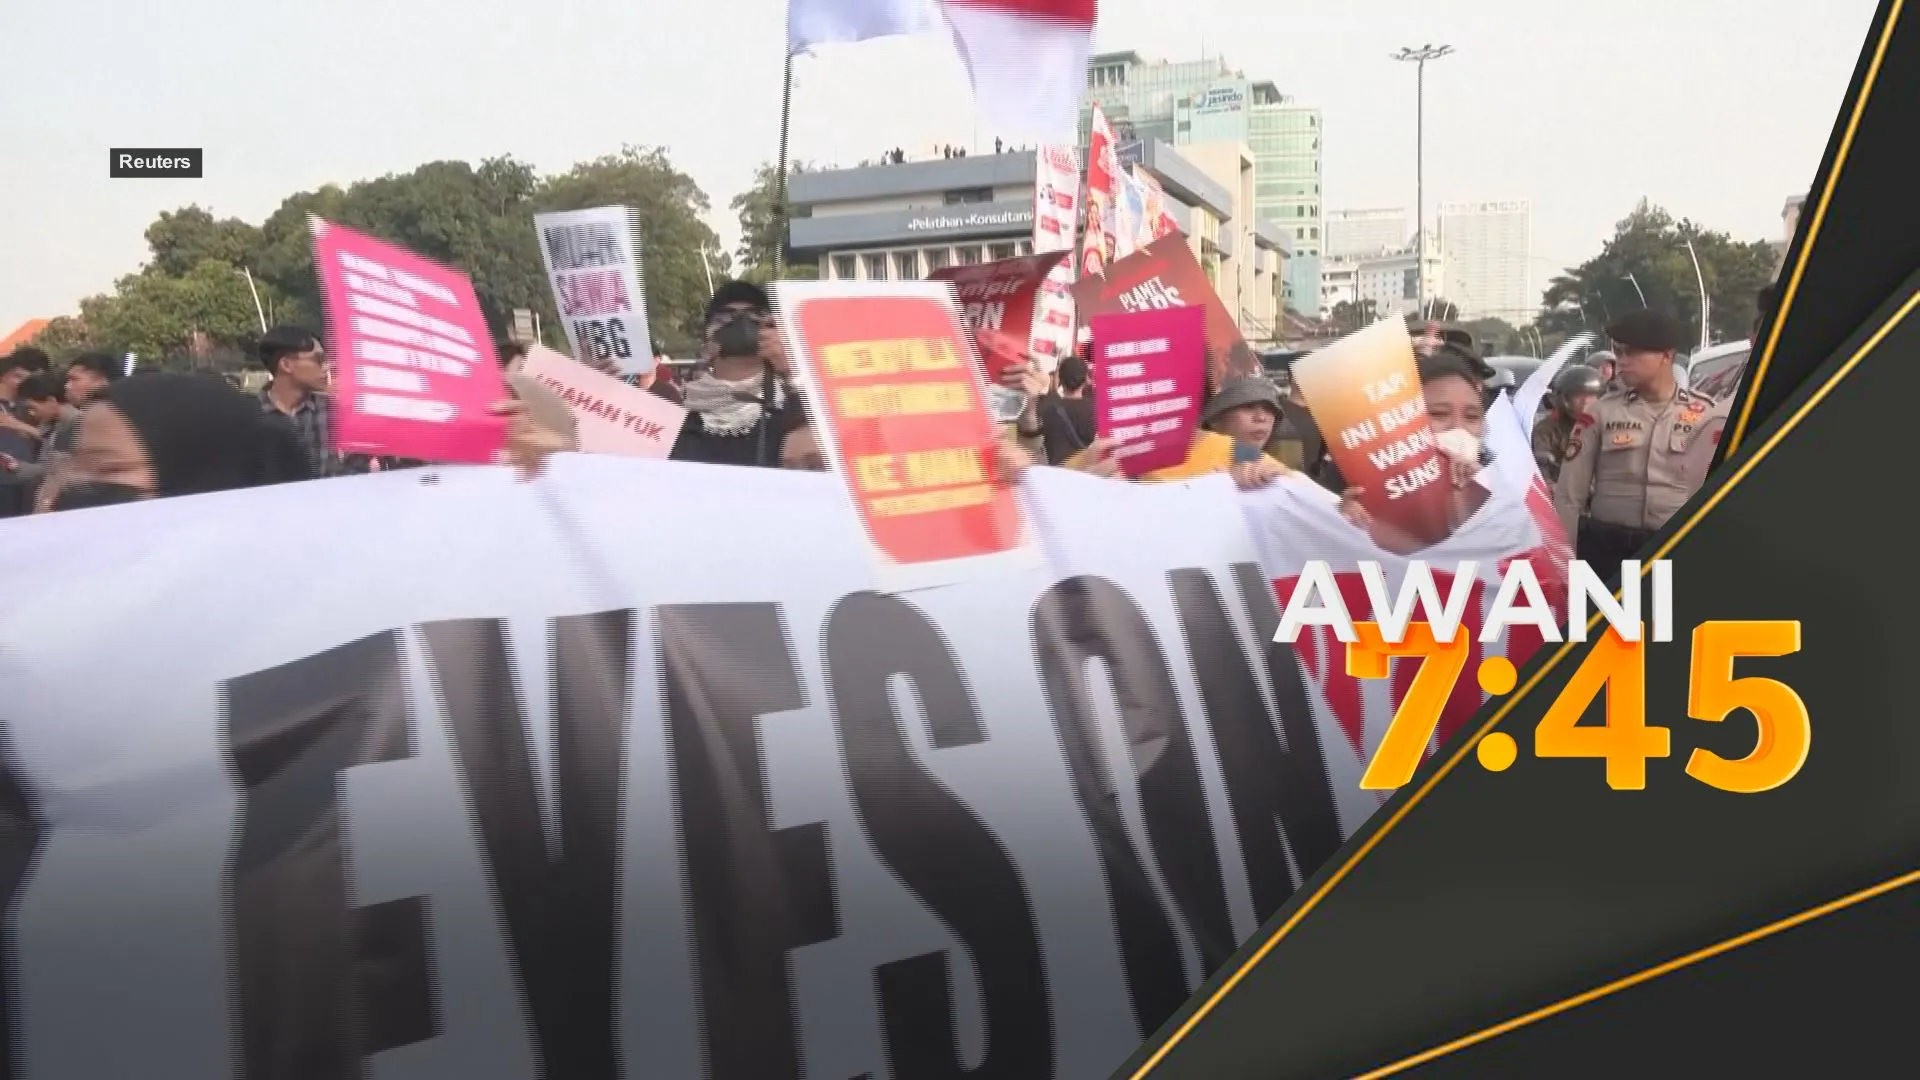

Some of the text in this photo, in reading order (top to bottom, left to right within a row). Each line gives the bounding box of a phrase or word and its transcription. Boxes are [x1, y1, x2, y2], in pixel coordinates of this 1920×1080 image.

[913, 215, 964, 232] Pelatihan
[556, 270, 632, 317] SAMA
[1118, 275, 1165, 310] PLANET
[623, 411, 666, 442] YUK
[1340, 418, 1379, 449] INI
[1605, 420, 1643, 432] AFRIZAL
[214, 588, 1057, 1080] EYES
[1029, 561, 1346, 1080] ON
